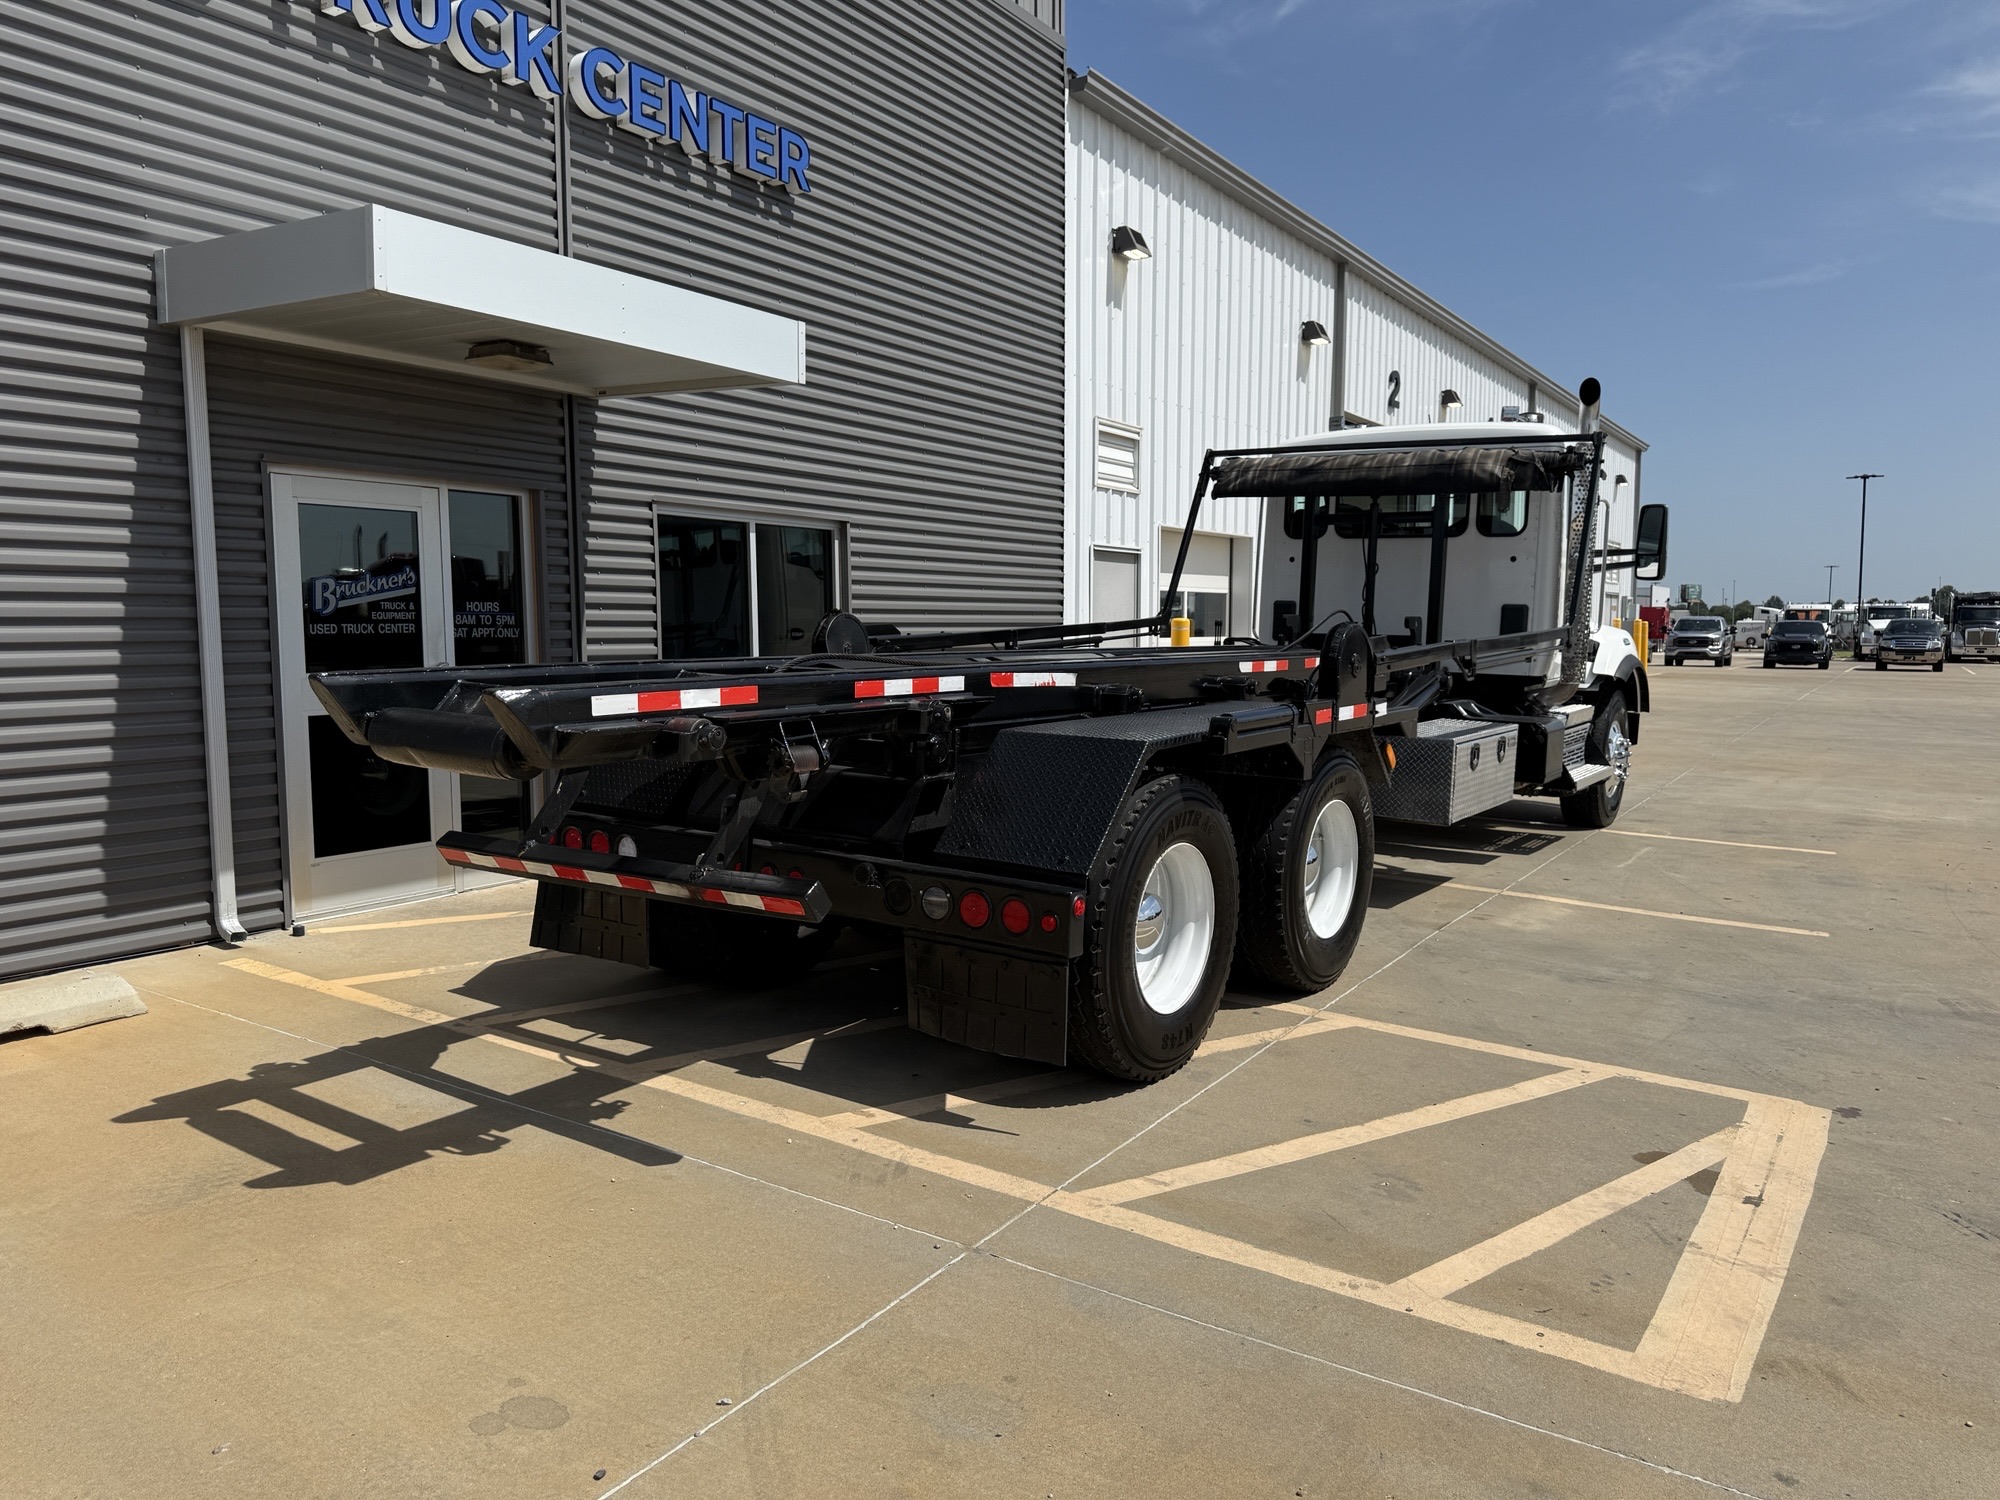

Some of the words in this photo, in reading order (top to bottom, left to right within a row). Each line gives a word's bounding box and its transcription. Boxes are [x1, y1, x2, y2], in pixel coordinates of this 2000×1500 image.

[576, 46, 812, 193] CENTER
[1388, 370, 1401, 409] 2
[313, 565, 417, 615] Bruckner's
[380, 601, 406, 610] TRUCK
[409, 602, 415, 610] &
[466, 601, 500, 612] HOURS
[371, 611, 416, 620] EQUIPMENT
[455, 614, 476, 625] 8AM
[479, 614, 493, 625] TO
[496, 614, 515, 625] 5PM
[309, 623, 338, 635] USED
[341, 623, 375, 634] TRUCK
[378, 622, 416, 634] CENTER
